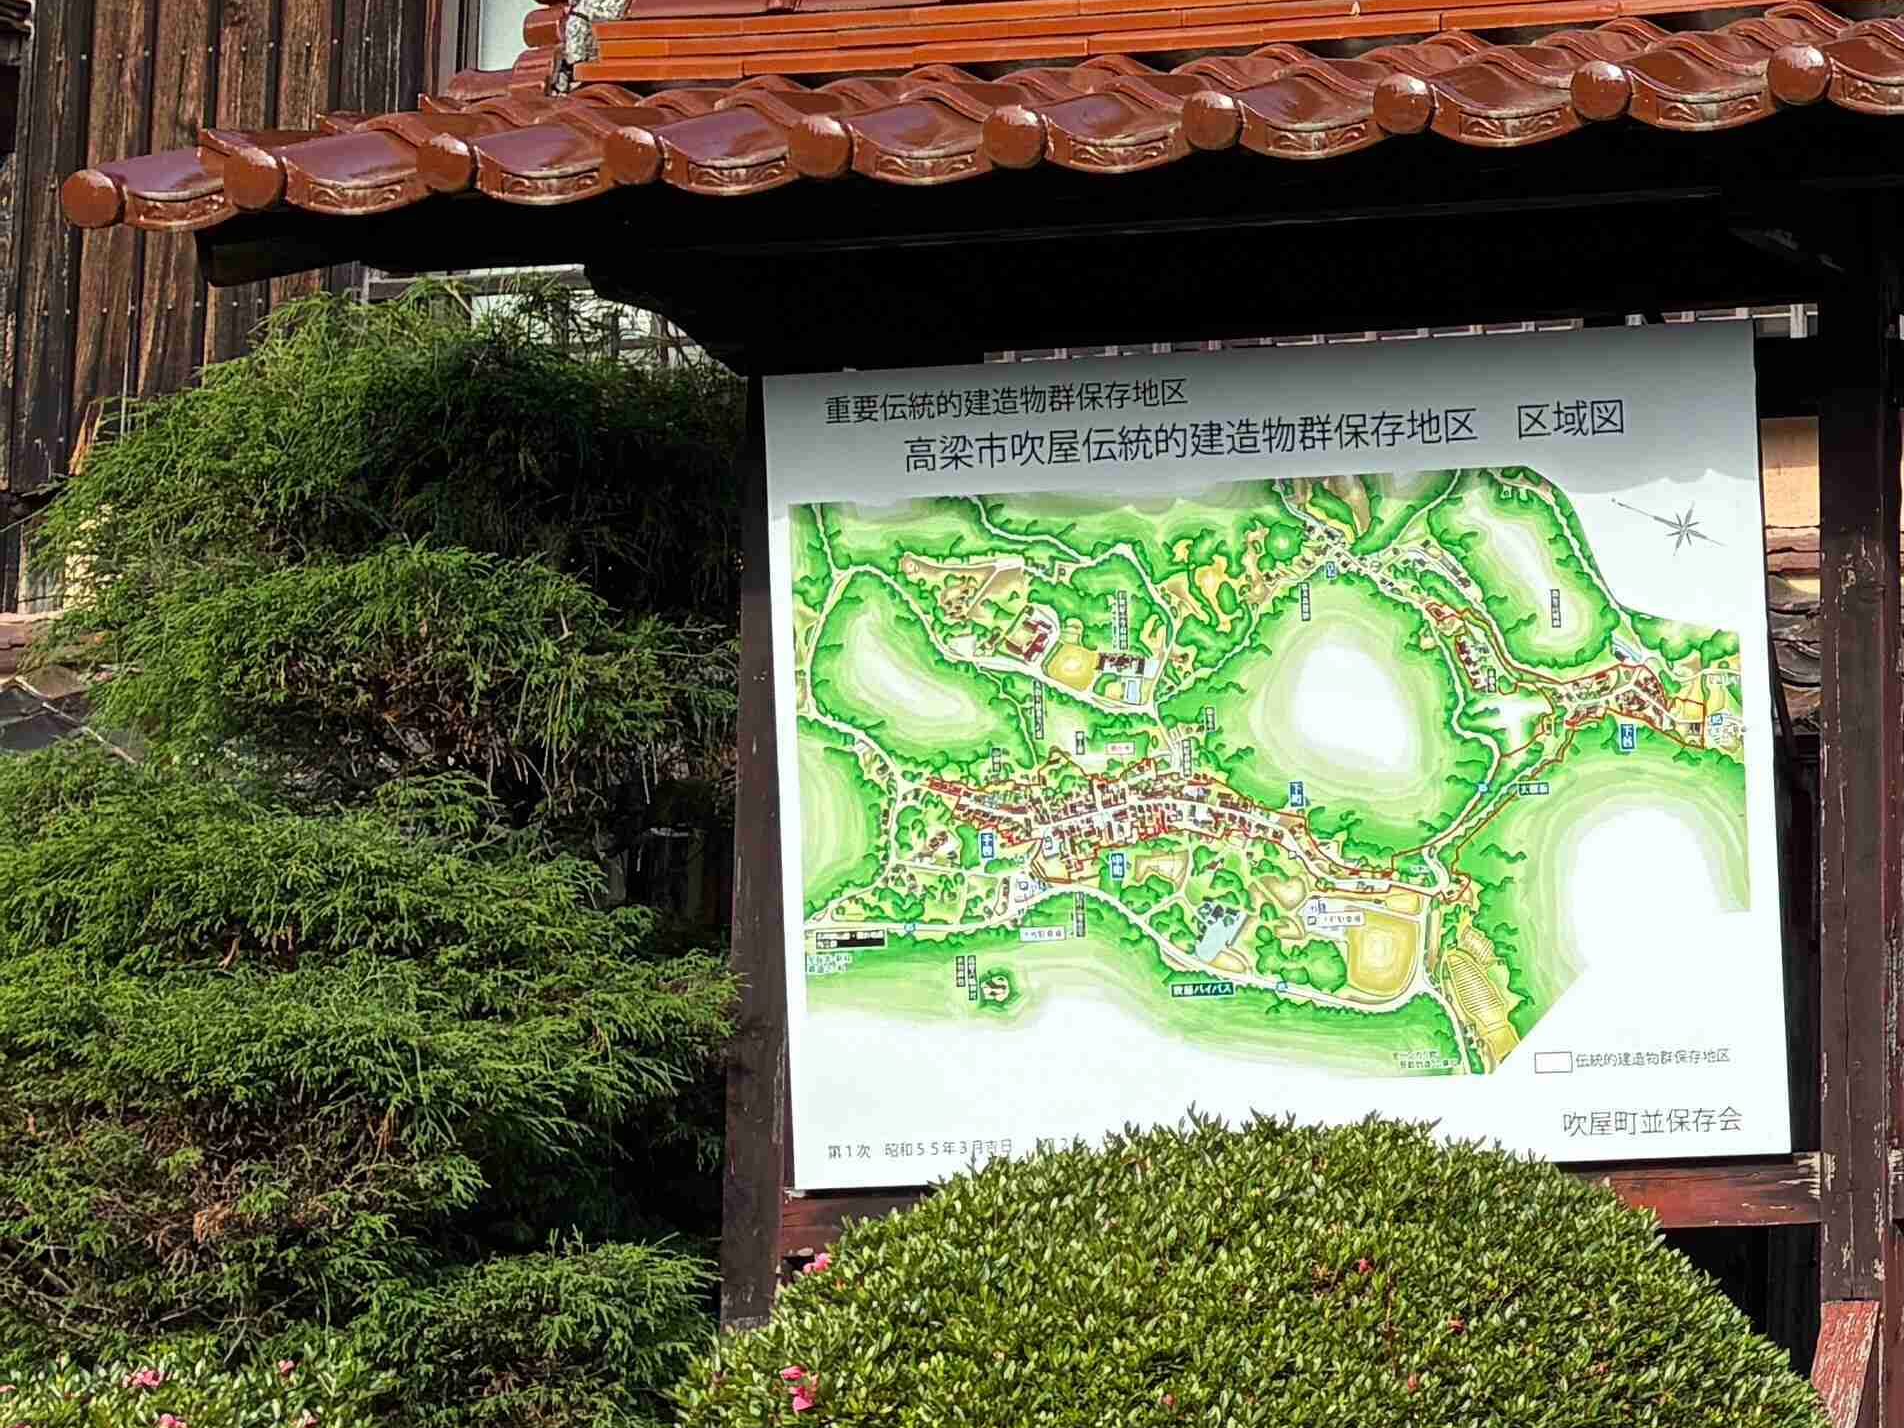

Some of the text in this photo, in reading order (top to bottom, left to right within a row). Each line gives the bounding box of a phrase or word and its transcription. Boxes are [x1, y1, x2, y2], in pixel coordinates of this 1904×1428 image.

[825, 377, 1188, 425] 重要伝統的建造物群保存地区
[904, 399, 1624, 473] 高梁市吹屋伝統的建造物群保存地区 区域図
[1576, 1047, 1731, 1067] 伝統的建造物群保存地区
[1563, 1106, 1743, 1137] 吹屋町並保存会
